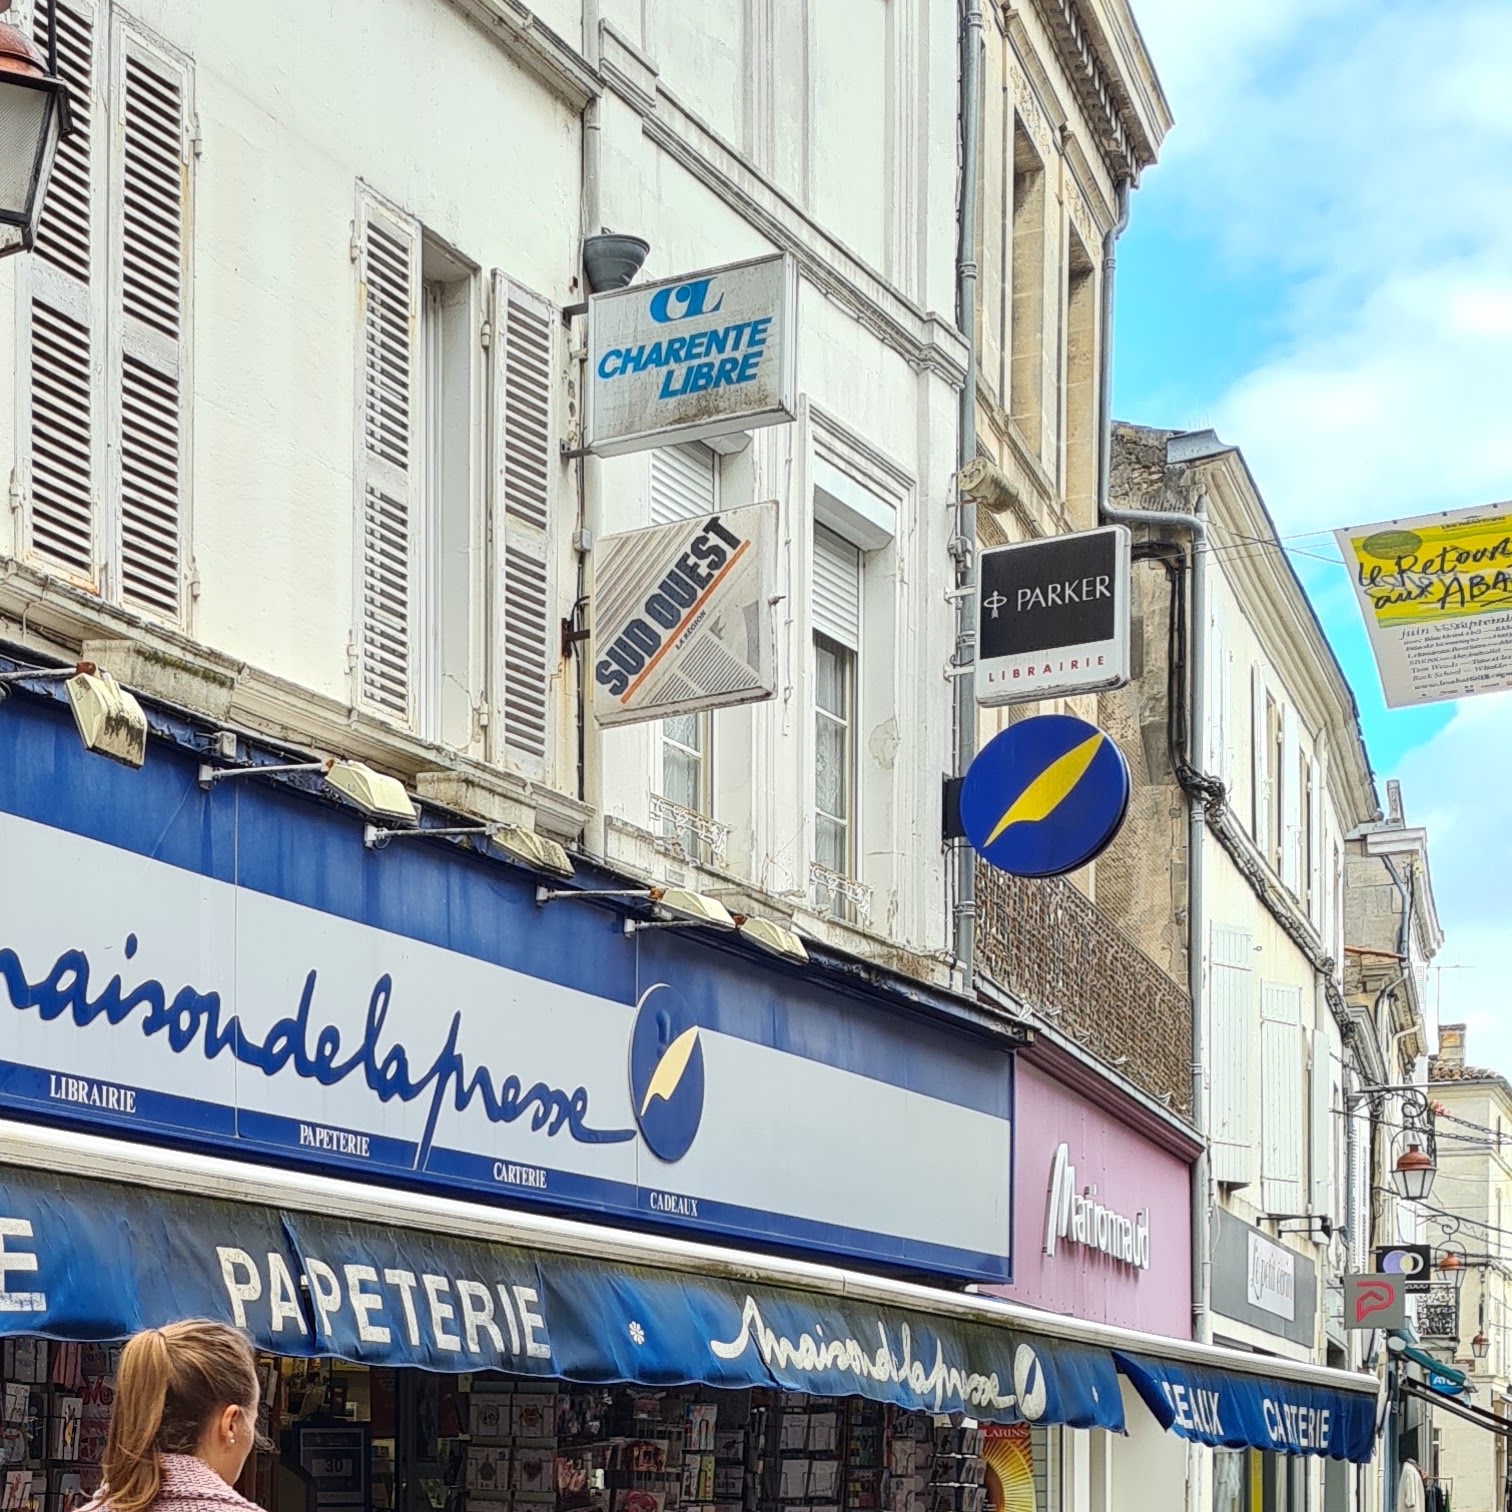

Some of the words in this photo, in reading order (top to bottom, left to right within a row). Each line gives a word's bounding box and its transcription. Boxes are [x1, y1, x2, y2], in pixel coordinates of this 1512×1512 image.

[597, 317, 773, 381] CHARENTE
[659, 350, 764, 400] LIBRE
[595, 618, 662, 697] SUD
[645, 516, 742, 631] OUEST
[1016, 575, 1113, 613] PARKER
[1436, 570, 1512, 611] ABA
[987, 655, 1107, 682] LIBRAIRIE
[48, 1074, 137, 1113] LIBRAIRIE
[299, 1124, 370, 1157] PAPETERIE
[493, 1161, 548, 1189] CARTERIE
[649, 1192, 699, 1218] CADEAUX
[215, 1245, 553, 1360] PAPETERIE
[982, 1427, 1030, 1439] LARINS
[325, 1458, 343, 1473] 30
